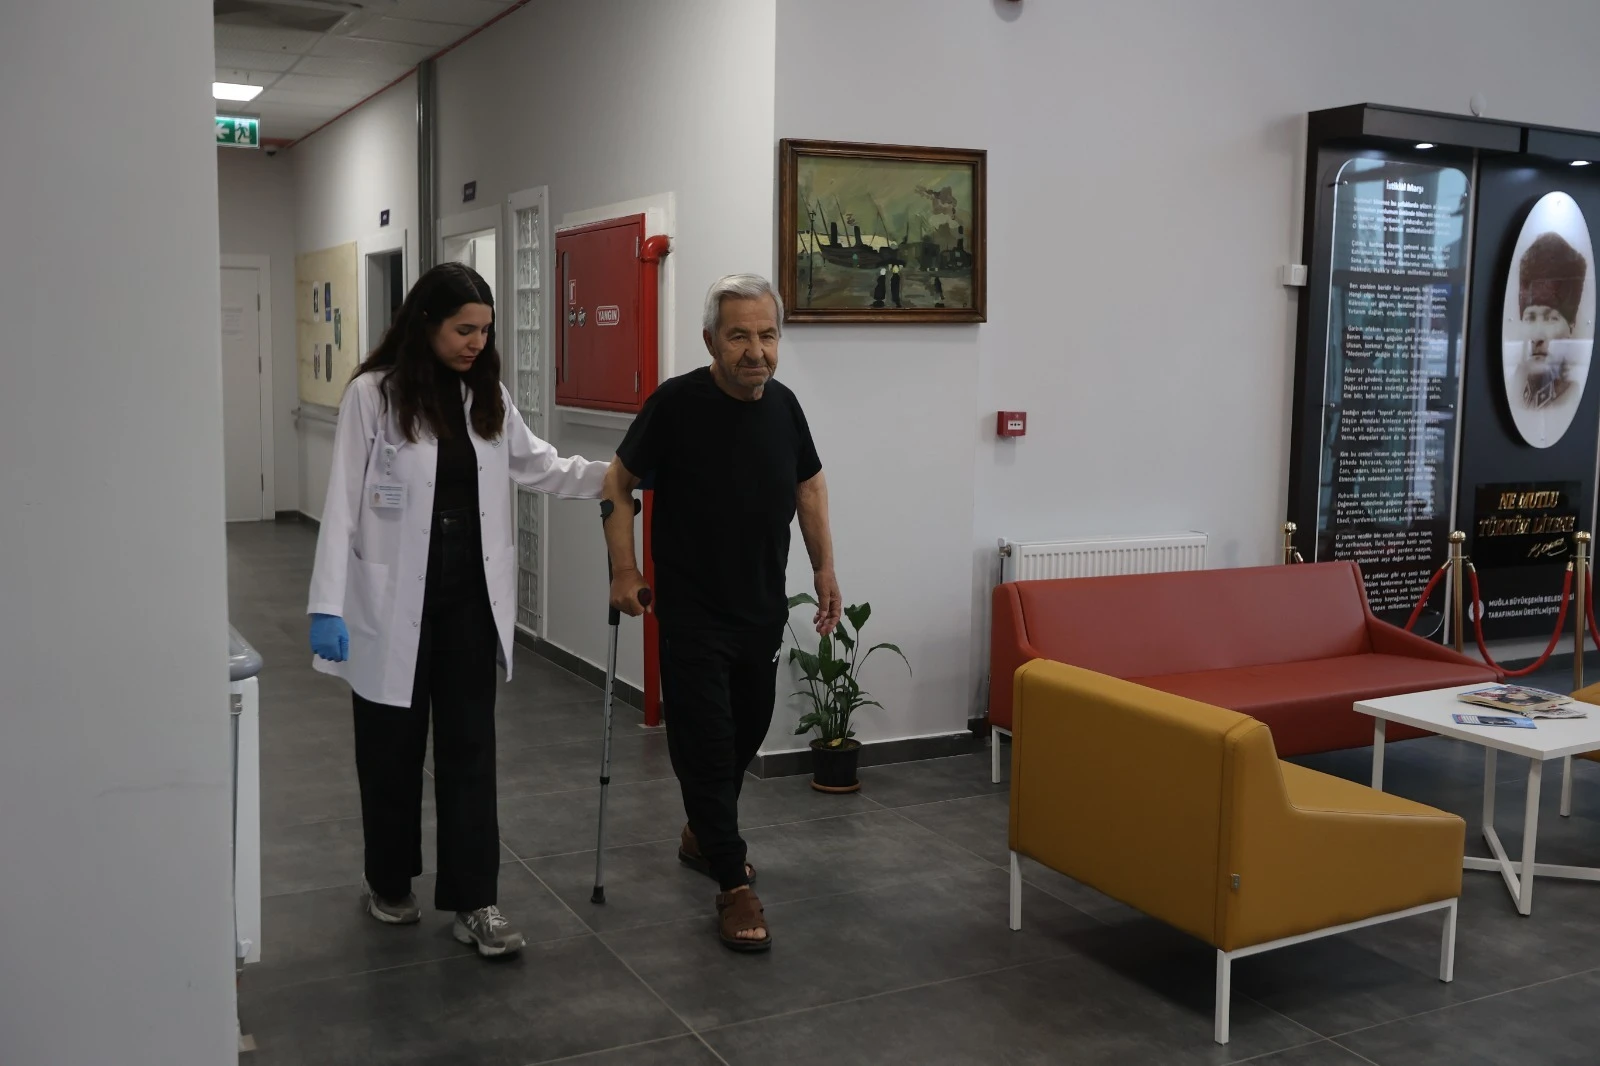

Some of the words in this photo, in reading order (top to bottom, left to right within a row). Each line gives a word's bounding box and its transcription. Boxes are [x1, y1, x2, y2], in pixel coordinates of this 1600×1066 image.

[598, 309, 617, 321] YANGIN
[1498, 492, 1516, 510] NE
[1518, 491, 1559, 508] MUTLU
[1488, 598, 1509, 607] MUĞLA
[1510, 595, 1543, 605] BÜYÜKŞEHİR
[1488, 609, 1523, 618] TARAFINDAN
[1523, 606, 1560, 616] ÜRETİLMİŞTİR
